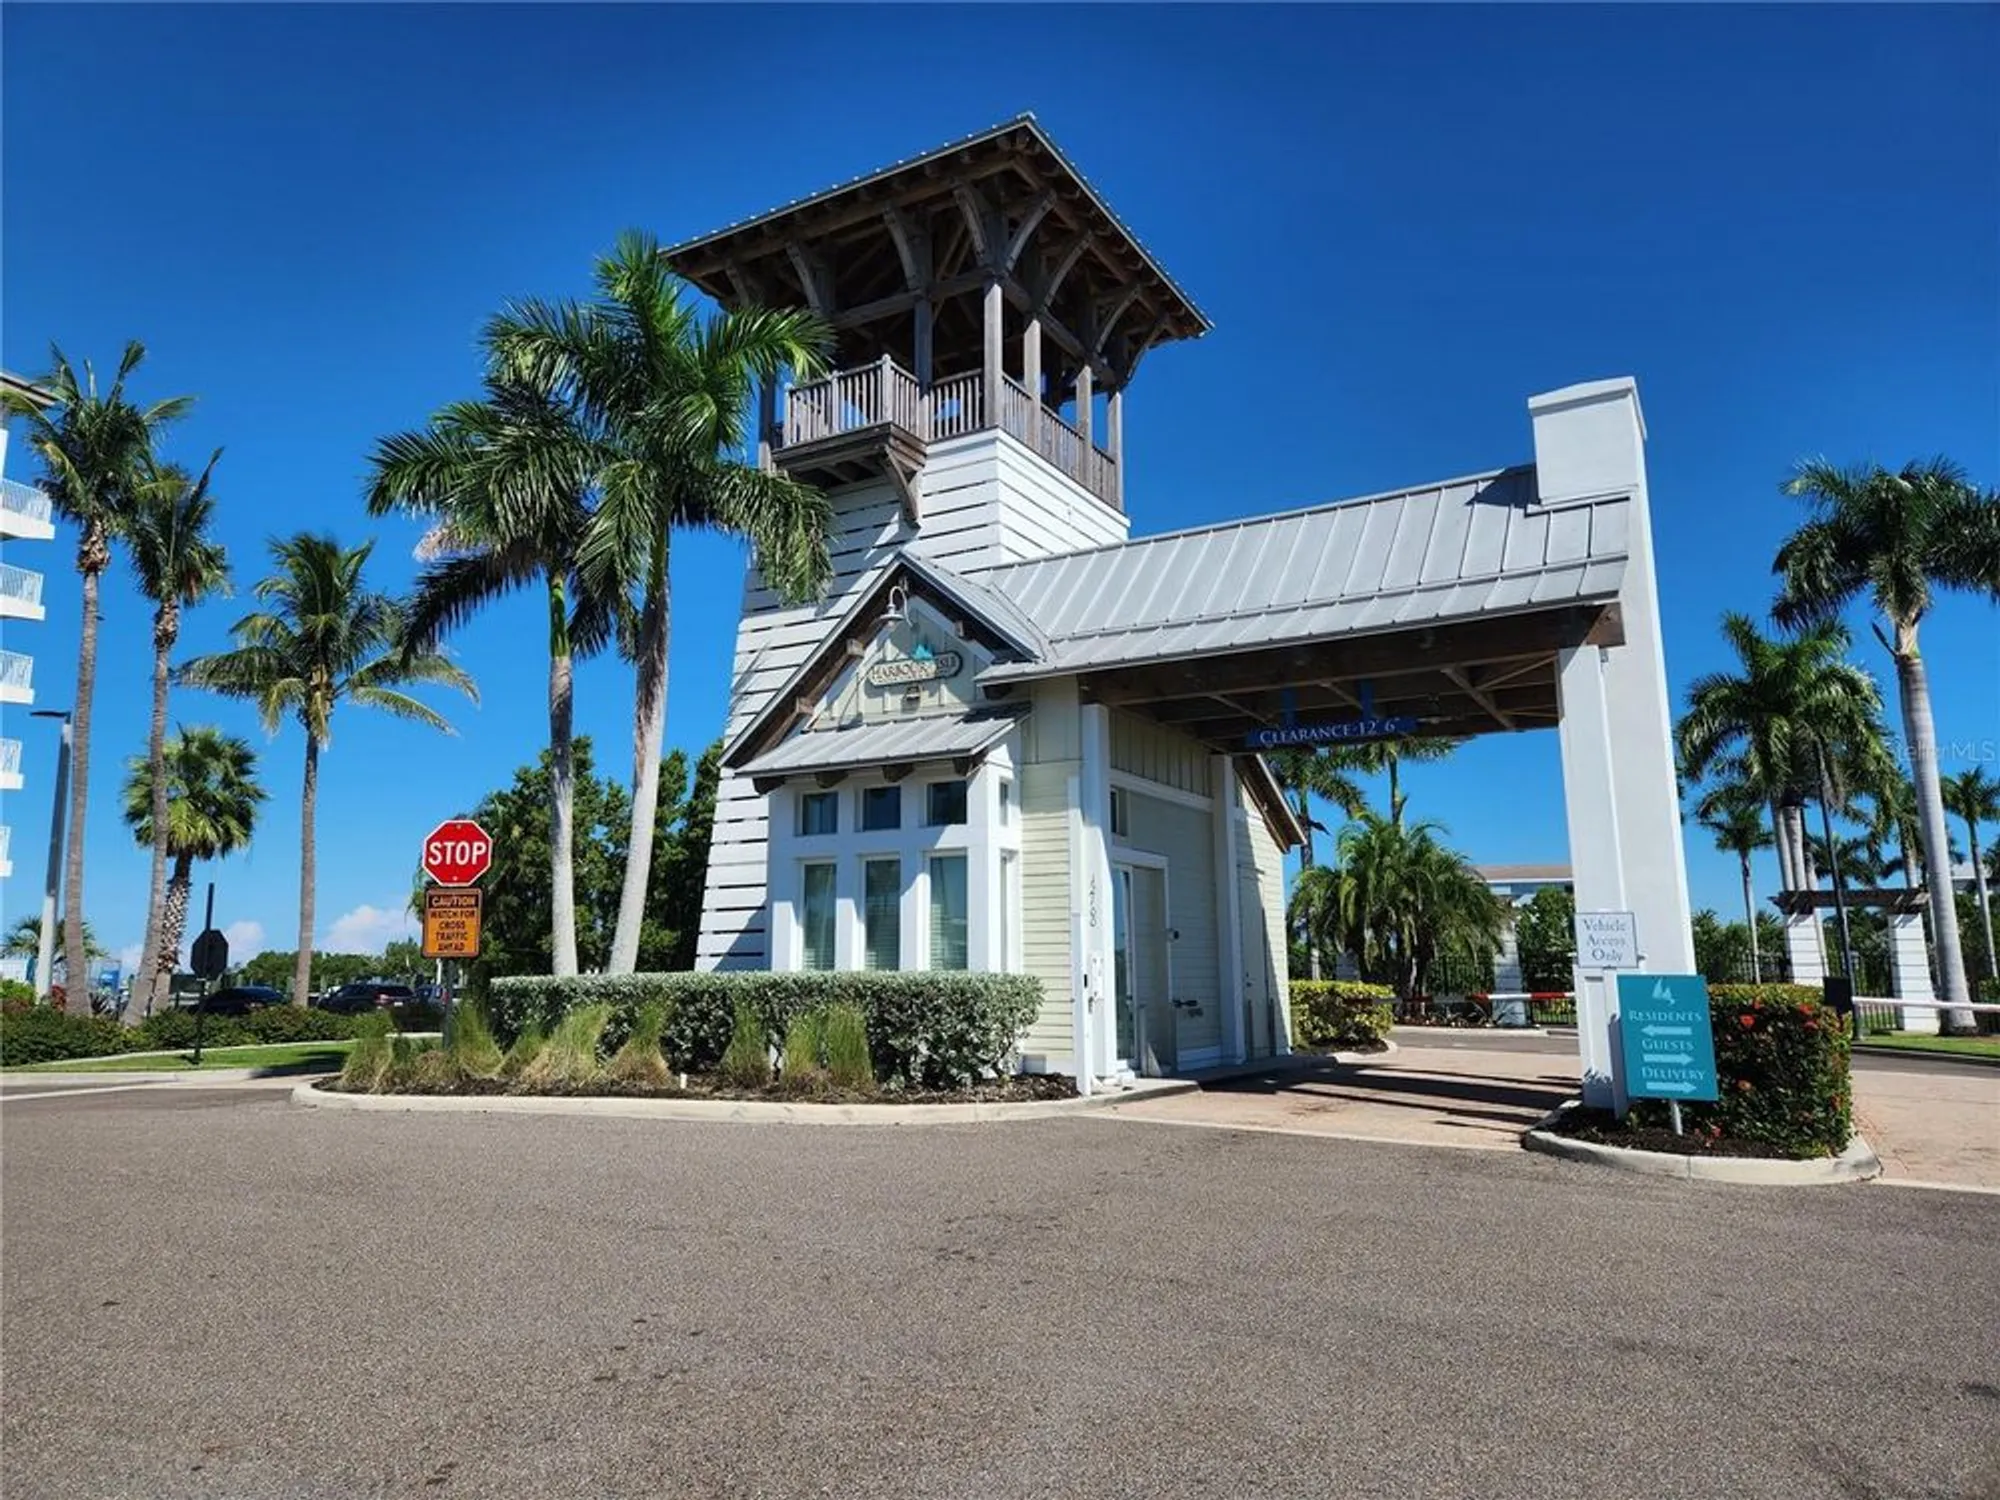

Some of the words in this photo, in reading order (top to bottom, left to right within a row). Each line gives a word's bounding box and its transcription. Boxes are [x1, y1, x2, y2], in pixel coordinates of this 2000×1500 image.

[1259, 722, 1350, 744] CLEARANCE
[428, 841, 487, 865] STOP
[431, 896, 476, 908] CAUTION
[430, 910, 457, 919] WATCH
[460, 910, 475, 918] FOR
[438, 920, 466, 930] CROSS
[1583, 919, 1626, 931] Vehicle
[436, 931, 468, 941] TRAFFIC
[1586, 934, 1626, 946] Access
[1592, 949, 1623, 962] Only
[1628, 1010, 1701, 1021] RESIDENTS
[1641, 1039, 1694, 1050] GUESTS
[1642, 1066, 1705, 1081] DELIVERY
